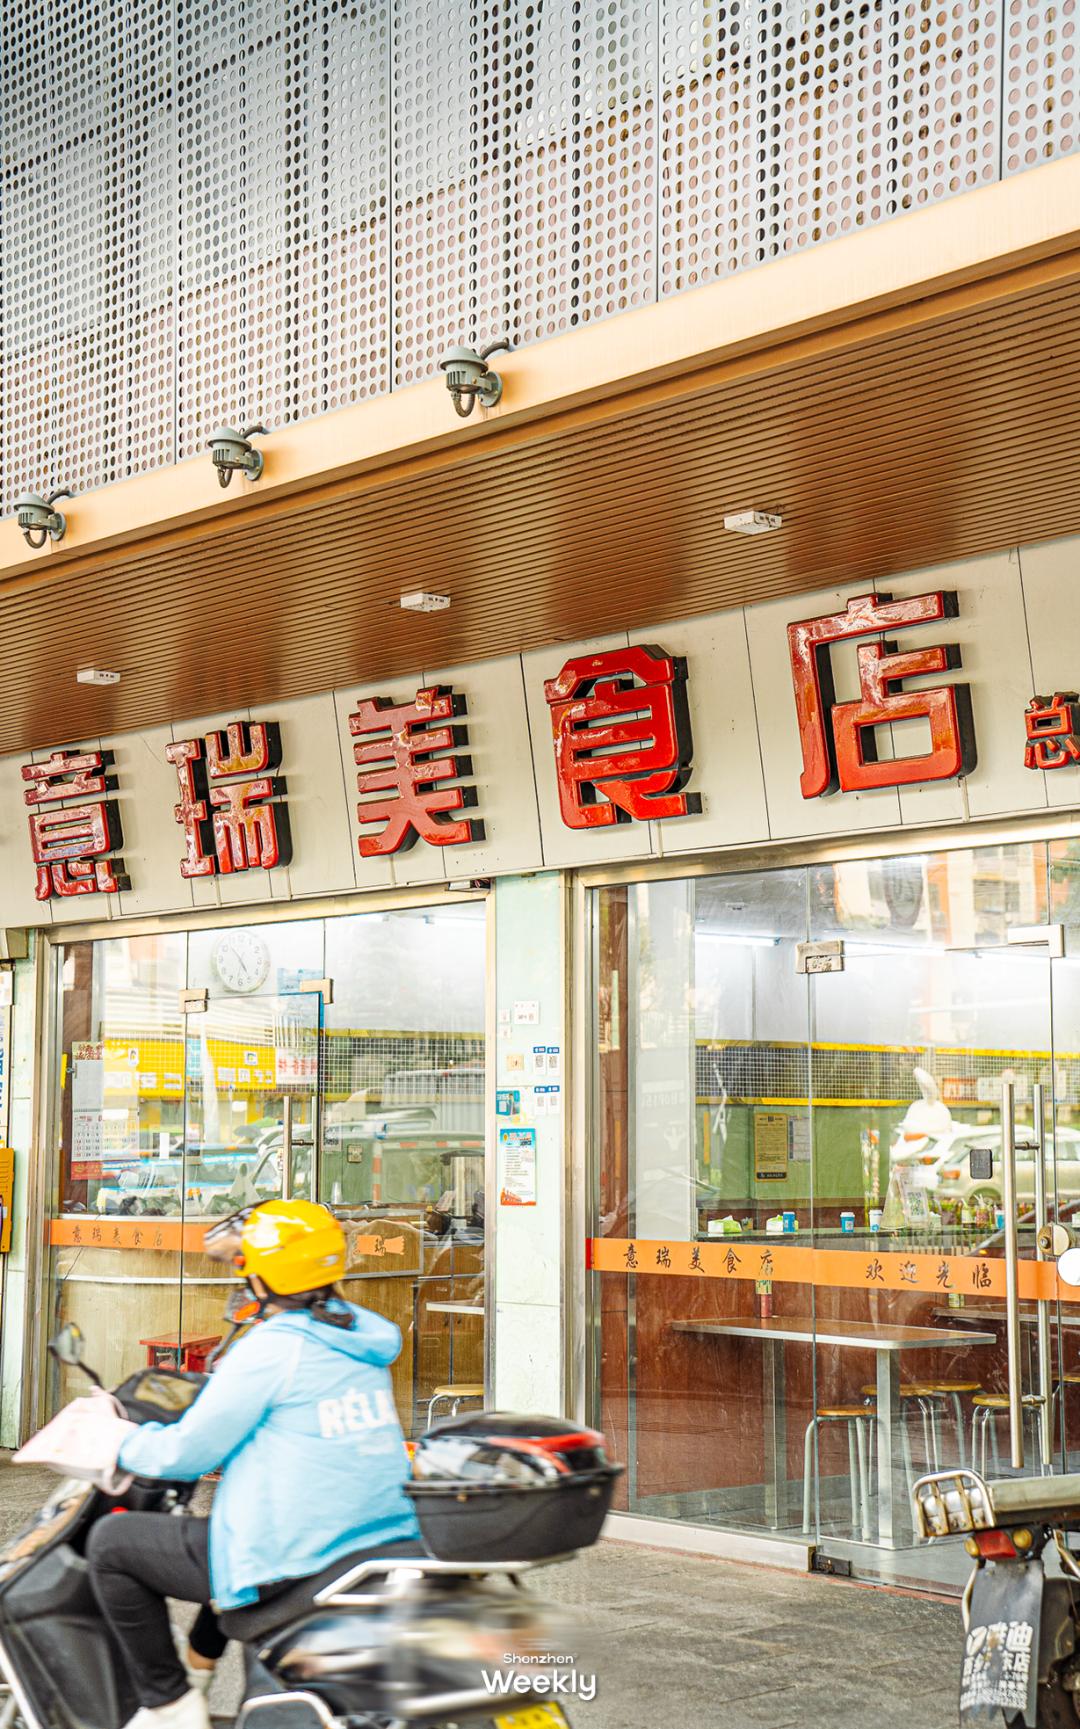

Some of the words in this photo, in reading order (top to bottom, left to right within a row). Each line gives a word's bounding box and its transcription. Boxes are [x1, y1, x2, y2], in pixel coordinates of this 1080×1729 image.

[623, 1243, 774, 1277] 意瑞美食店
[865, 1258, 992, 1289] 欢迎光临
